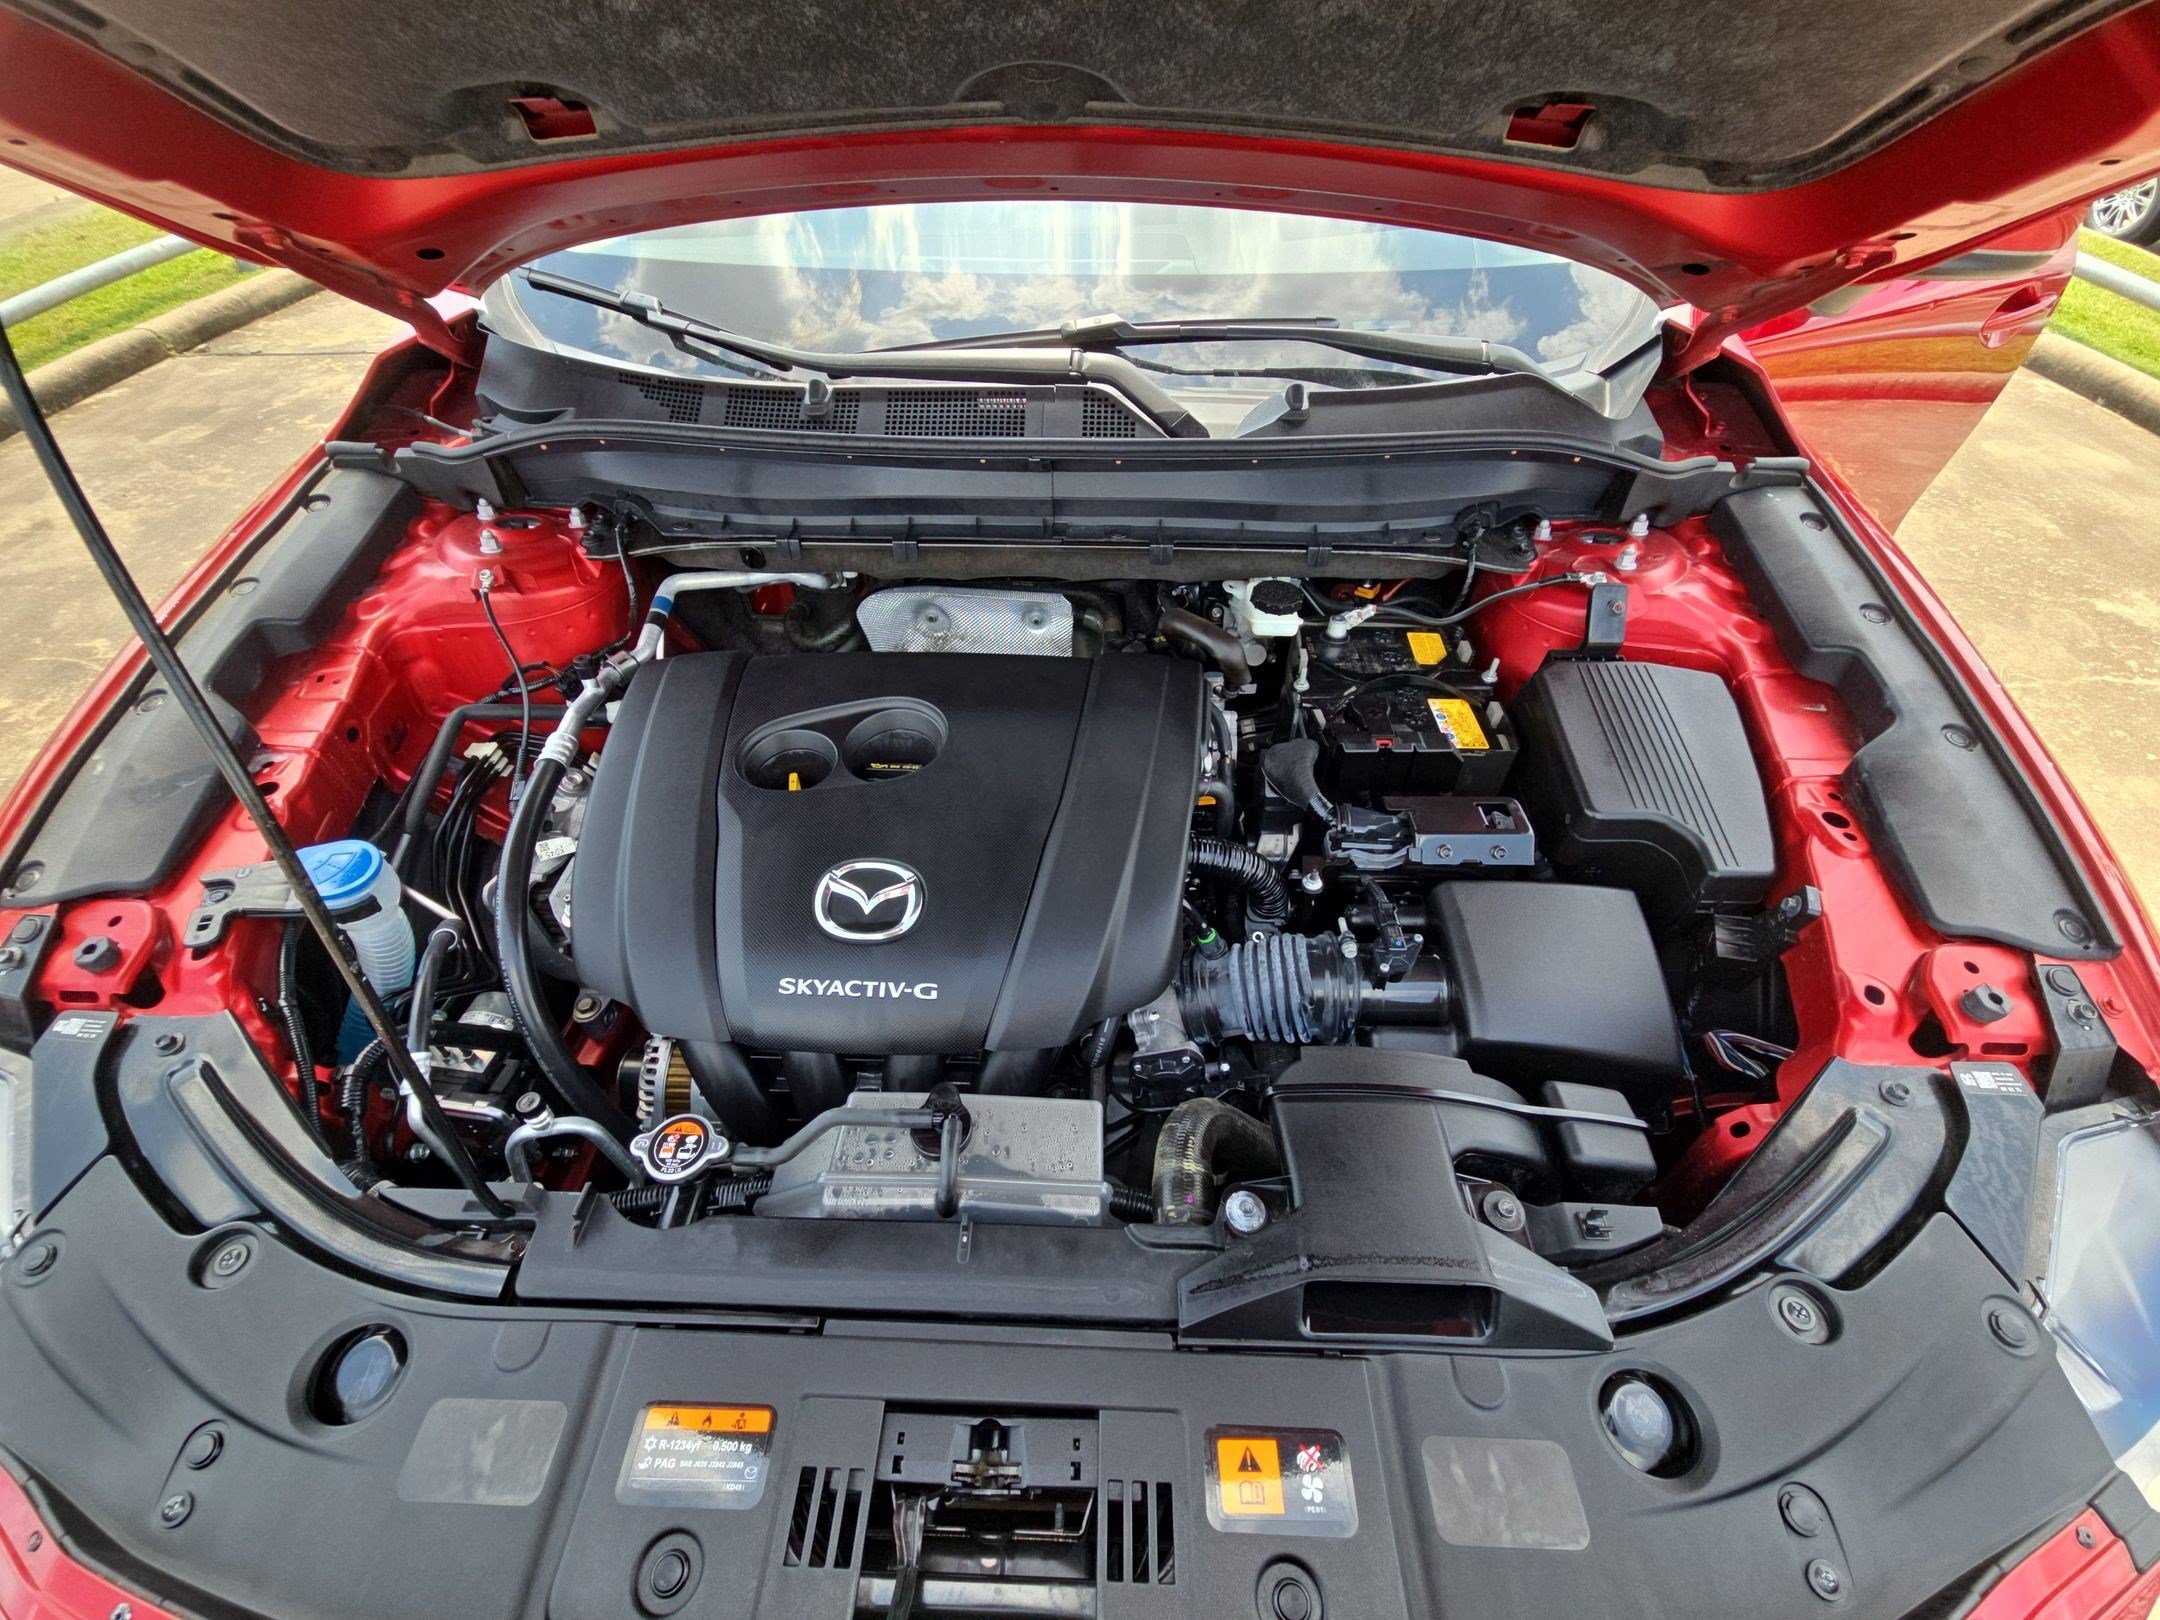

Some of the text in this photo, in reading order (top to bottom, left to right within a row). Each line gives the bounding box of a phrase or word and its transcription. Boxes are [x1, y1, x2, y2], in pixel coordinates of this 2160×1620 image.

[778, 977, 938, 1000] SKYACTIV-G
[659, 1439, 752, 1454] R-1234yf 0.500 kg
[654, 1458, 676, 1468] PAG
